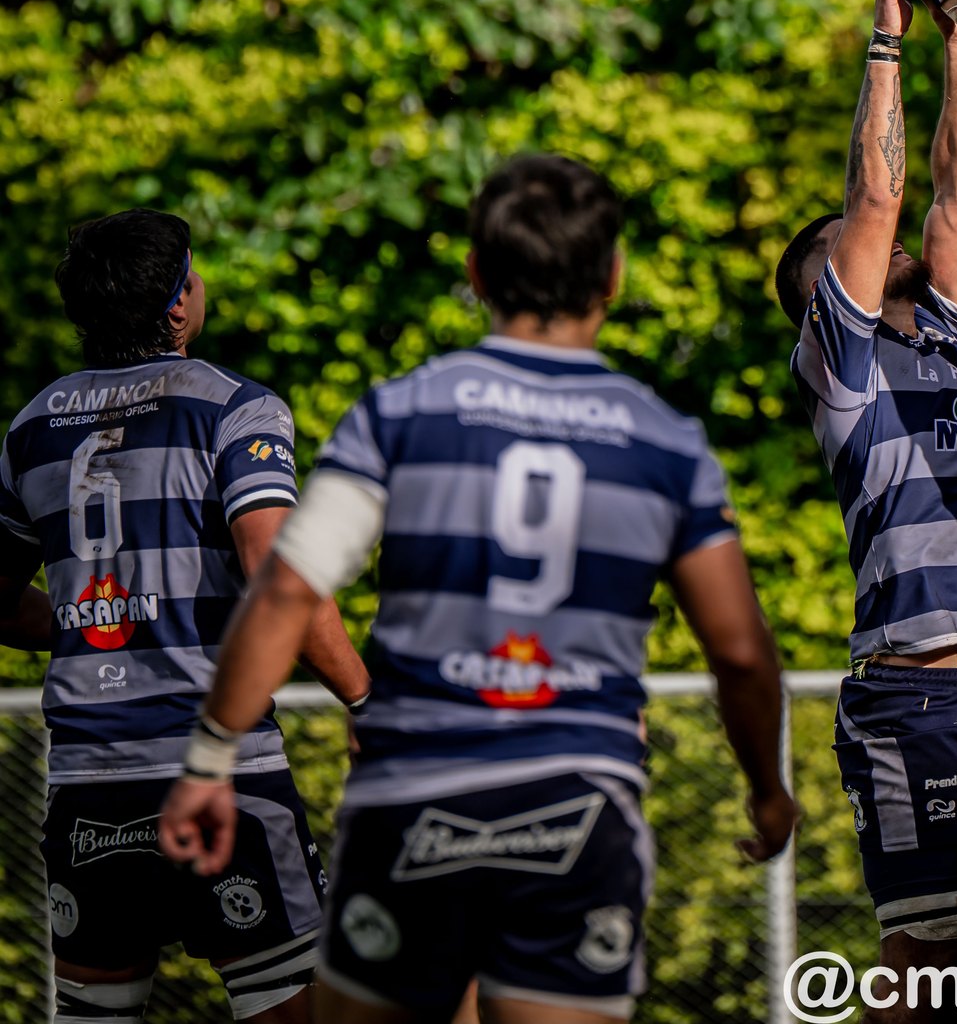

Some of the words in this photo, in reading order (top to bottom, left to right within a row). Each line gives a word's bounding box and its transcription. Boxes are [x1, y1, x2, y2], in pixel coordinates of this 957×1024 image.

[916, 359, 939, 383] La
[46, 375, 165, 415] CAMINOA
[49, 409, 125, 428] CONCESIONARIO
[124, 401, 160, 417] OFICIAL
[69, 426, 125, 562] 6
[487, 440, 586, 615] 9
[98, 679, 127, 691] quince
[928, 812, 957, 823] quince
[69, 825, 161, 855] Budweis
[212, 874, 259, 897] Panther
